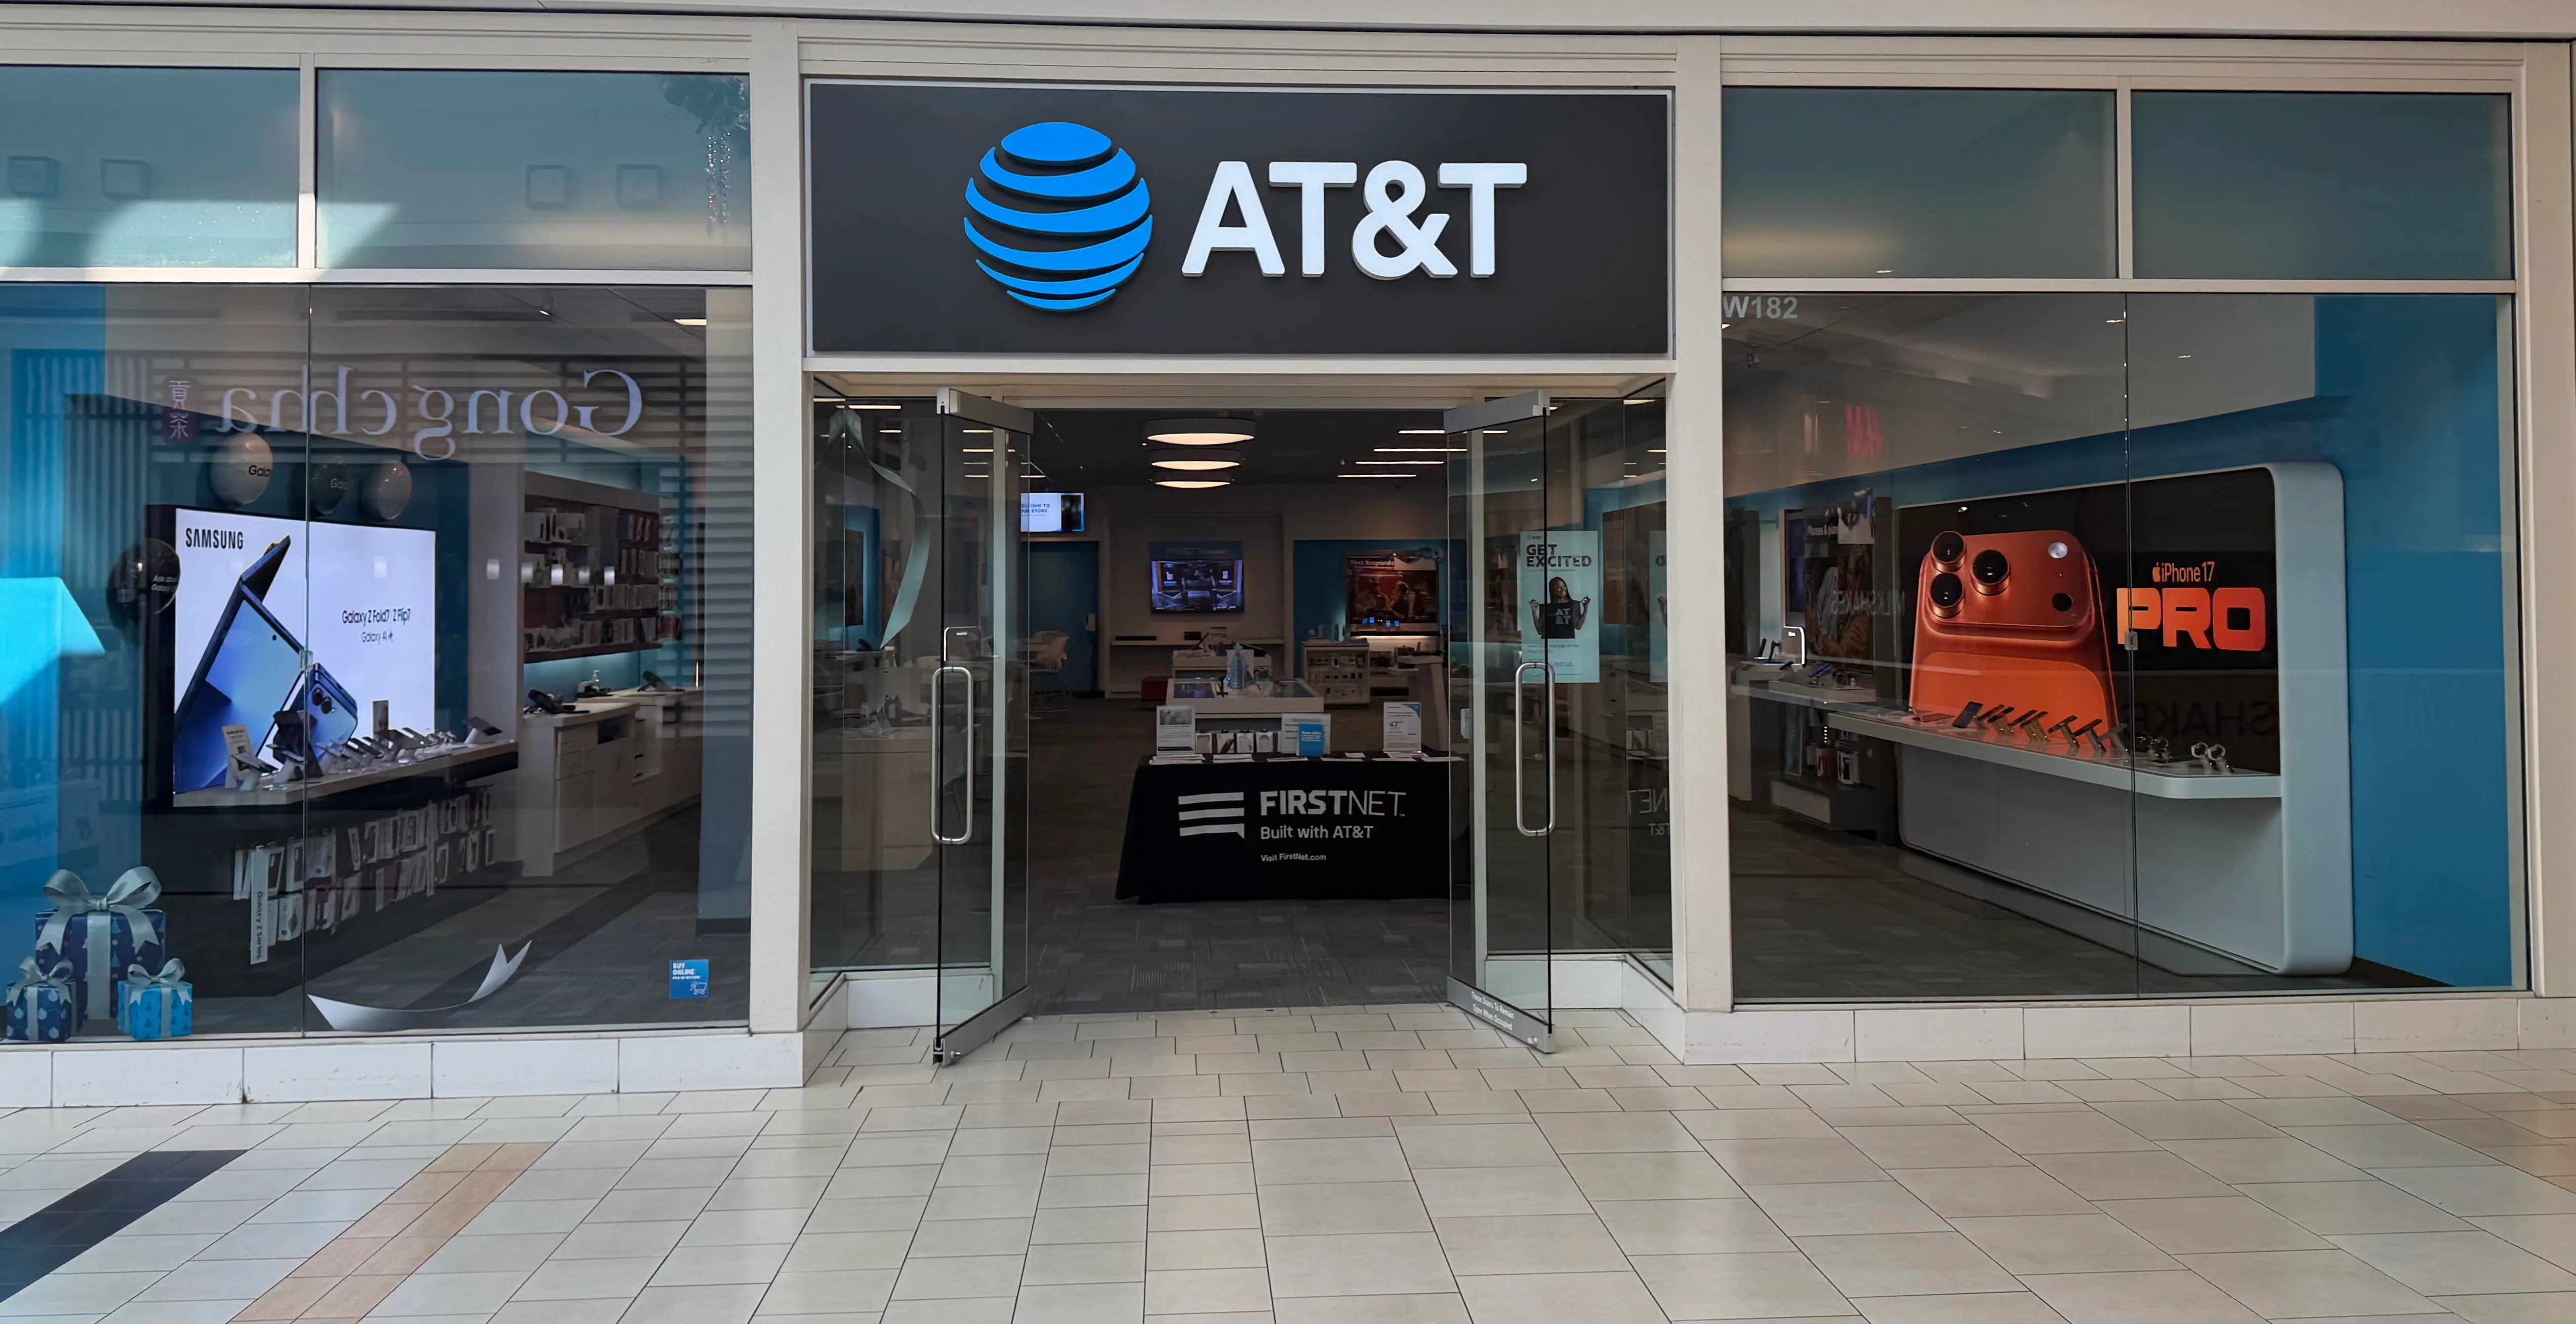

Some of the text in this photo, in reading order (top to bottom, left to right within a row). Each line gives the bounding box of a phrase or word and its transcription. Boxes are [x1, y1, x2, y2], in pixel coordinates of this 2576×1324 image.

[1182, 160, 1527, 280] AT&T
[1723, 296, 1798, 318] W182
[186, 528, 243, 550] SAMSUNG
[1526, 544, 1557, 556] GET
[1527, 556, 1592, 567] EXCITED
[2161, 561, 2215, 582] iPhone 17
[342, 610, 367, 627] Galaxy
[2117, 588, 2266, 651] PRO
[361, 632, 381, 645] Galaxy
[1261, 825, 1374, 840] Built with AT&T
[1279, 853, 1326, 861] FirstNet.com
